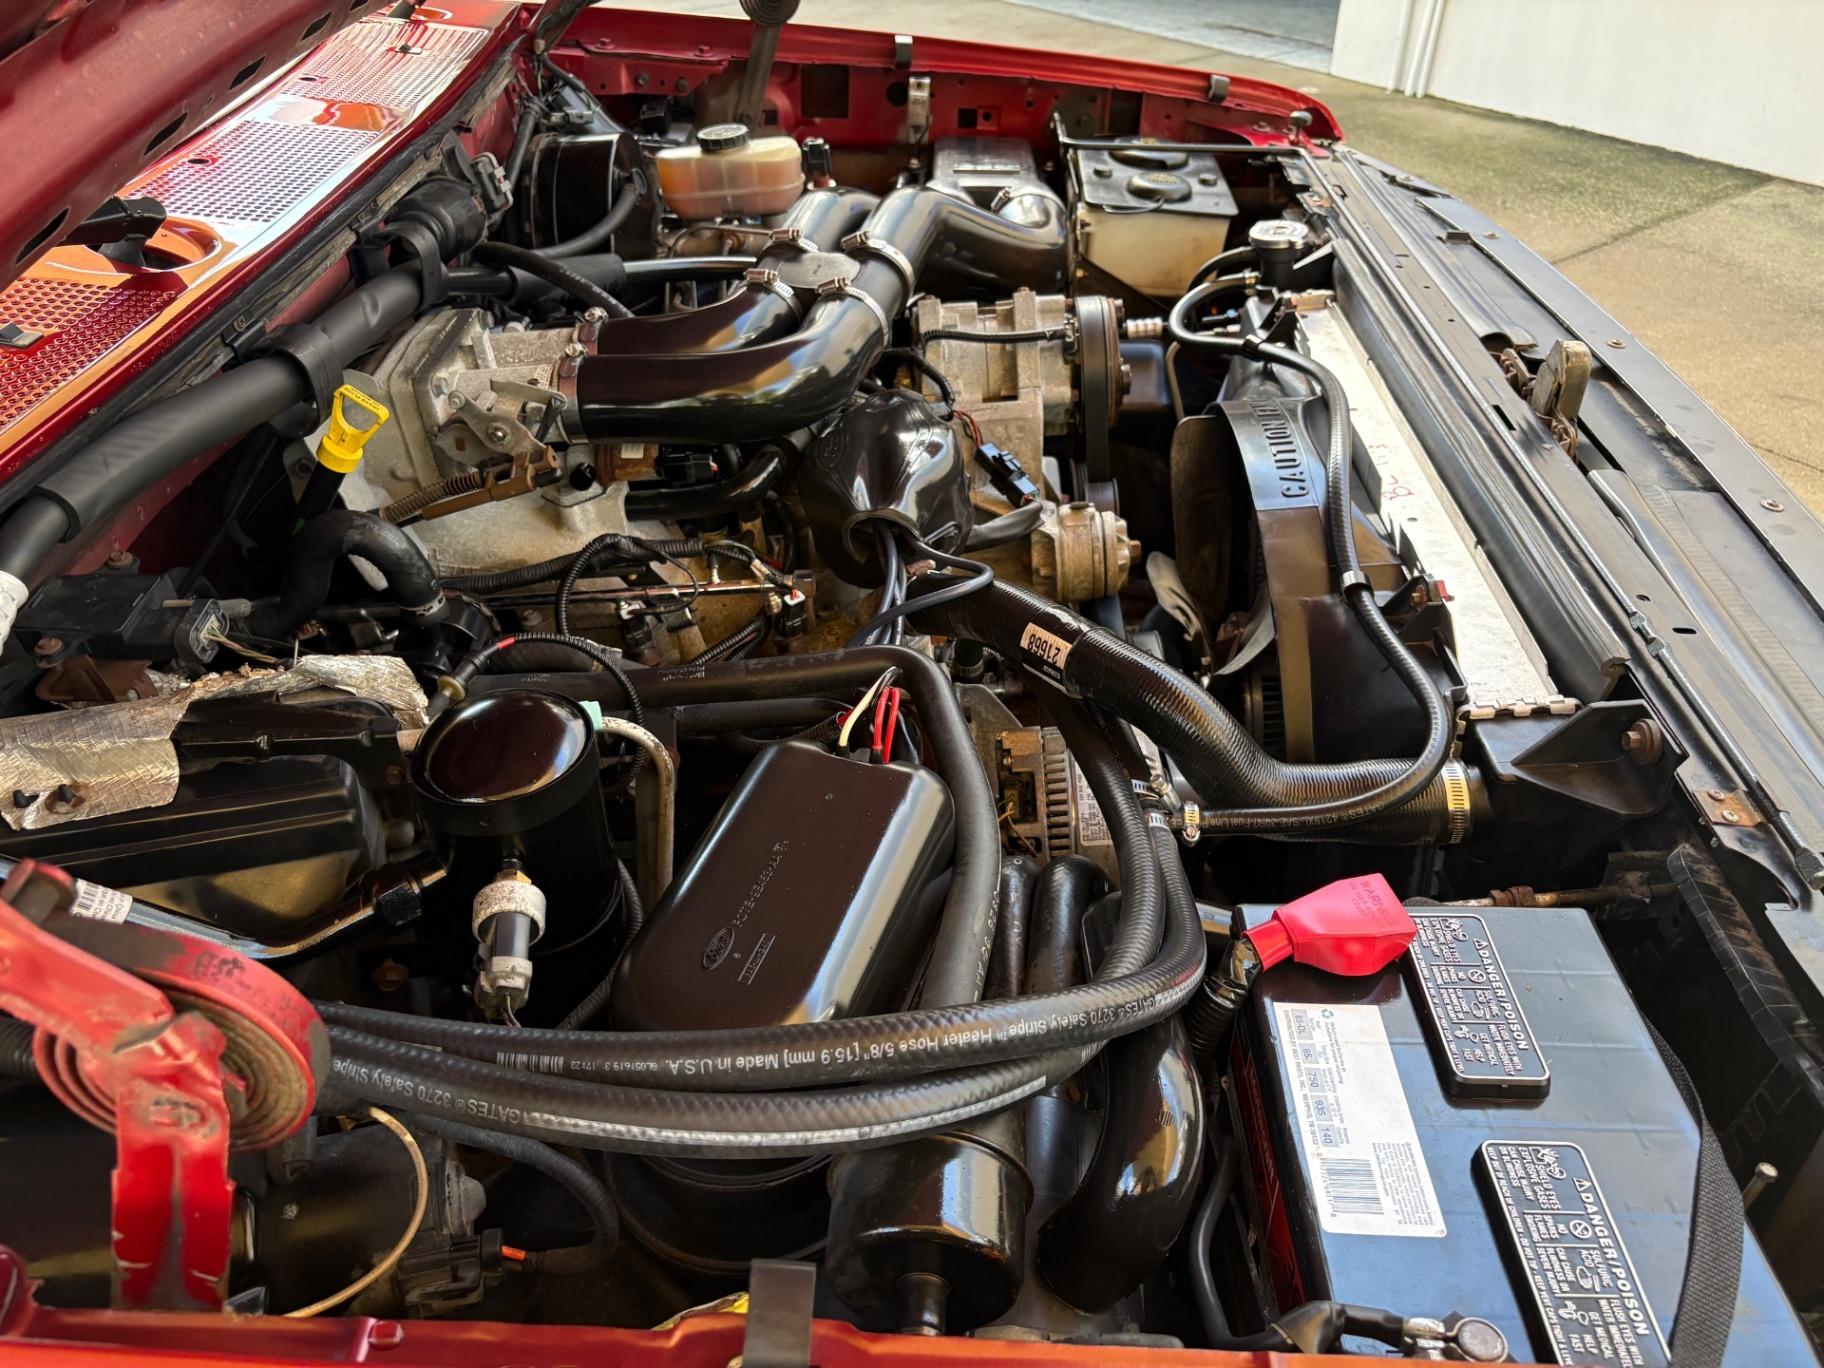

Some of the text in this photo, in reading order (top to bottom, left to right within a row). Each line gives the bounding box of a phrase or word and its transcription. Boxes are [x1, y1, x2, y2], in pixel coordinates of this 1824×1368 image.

[1261, 421, 1309, 498] CAUTION
[1027, 634, 1060, 663] 21668
[1209, 817, 1227, 828] Line
[1230, 817, 1250, 828] Fuel
[1451, 949, 1462, 962] EYES
[1478, 950, 1529, 1049] DANGER/POISON
[1048, 1011, 1087, 1031] Safety
[1090, 1006, 1114, 1024] 3270
[898, 1035, 937, 1052] Hose
[942, 1027, 991, 1047] Heater
[1505, 1042, 1517, 1054] EYES
[783, 1048, 815, 1068] mm]
[820, 1042, 859, 1065] [15.9
[863, 1040, 894, 1058] 5/8"
[1462, 1049, 1473, 1060] FAST
[1474, 1049, 1486, 1061] HELP
[331, 1058, 368, 1083] Stripe
[664, 1057, 713, 1073] U.S.A.
[717, 1056, 731, 1072] in
[735, 1053, 779, 1070] Made
[370, 1069, 413, 1096] Safety
[1307, 1072, 1320, 1087] 750
[417, 1084, 451, 1107] 3270
[1314, 1100, 1327, 1116] 935
[1321, 1127, 1333, 1143] 140
[1502, 1155, 1520, 1186] BLINDNESS
[1507, 1147, 1535, 1199] CAN CAUSE INJURY
[1519, 1148, 1551, 1208] EXPLOSIVE GASES
[1535, 1164, 1561, 1208] SHIELD EYES
[1524, 1215, 1541, 1241] SMOKING
[1534, 1215, 1550, 1238] FLAMES
[1543, 1215, 1559, 1238] SPARKS
[1556, 1224, 1568, 1233] NO
[1486, 1147, 1498, 1159] KEEP
[1508, 1206, 1525, 1232] CHILDREN
[1545, 1308, 1558, 1323] CAPS
[1560, 1350, 1574, 1366] LEVE
[1556, 1248, 1576, 1281] CAN CAUSE
[1578, 1193, 1652, 1335] DANGER/POISON
[1579, 1250, 1595, 1266] ACID
[1589, 1250, 1613, 1286] SULFURIC
[1537, 1248, 1561, 1293] SEVERE INJURY
[1546, 1248, 1570, 1291] BLINDNESS OR
[1568, 1335, 1584, 1352] FAST
[1582, 1335, 1599, 1352] HELP
[1588, 1312, 1615, 1358] GET MEDICAL
[1598, 1300, 1634, 1368] WATER IMMEDIATEL
[1609, 1300, 1645, 1364] FLUSH EYES WITH
